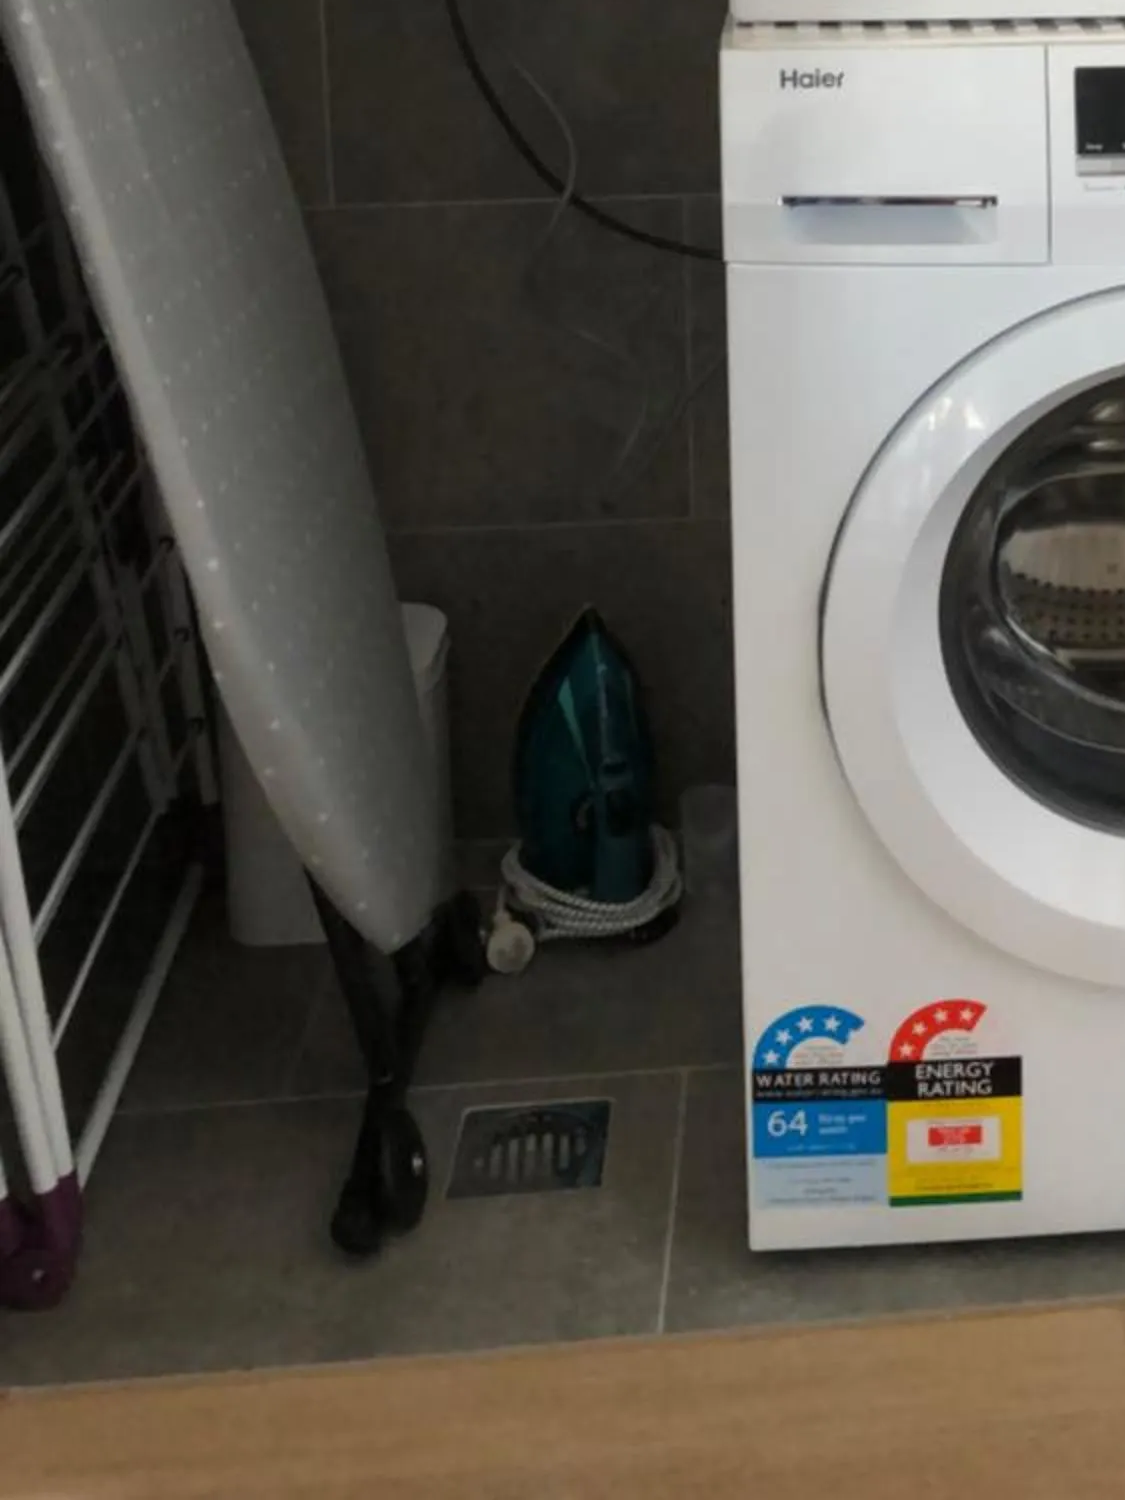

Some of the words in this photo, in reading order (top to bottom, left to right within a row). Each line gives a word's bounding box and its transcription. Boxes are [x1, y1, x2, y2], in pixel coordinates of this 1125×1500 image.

[780, 67, 845, 89] Haier
[756, 1072, 814, 1087] WATER
[818, 1069, 882, 1086] RATING
[915, 1061, 995, 1080] ENERGY
[917, 1079, 993, 1098] RATING
[767, 1110, 808, 1137] 64
